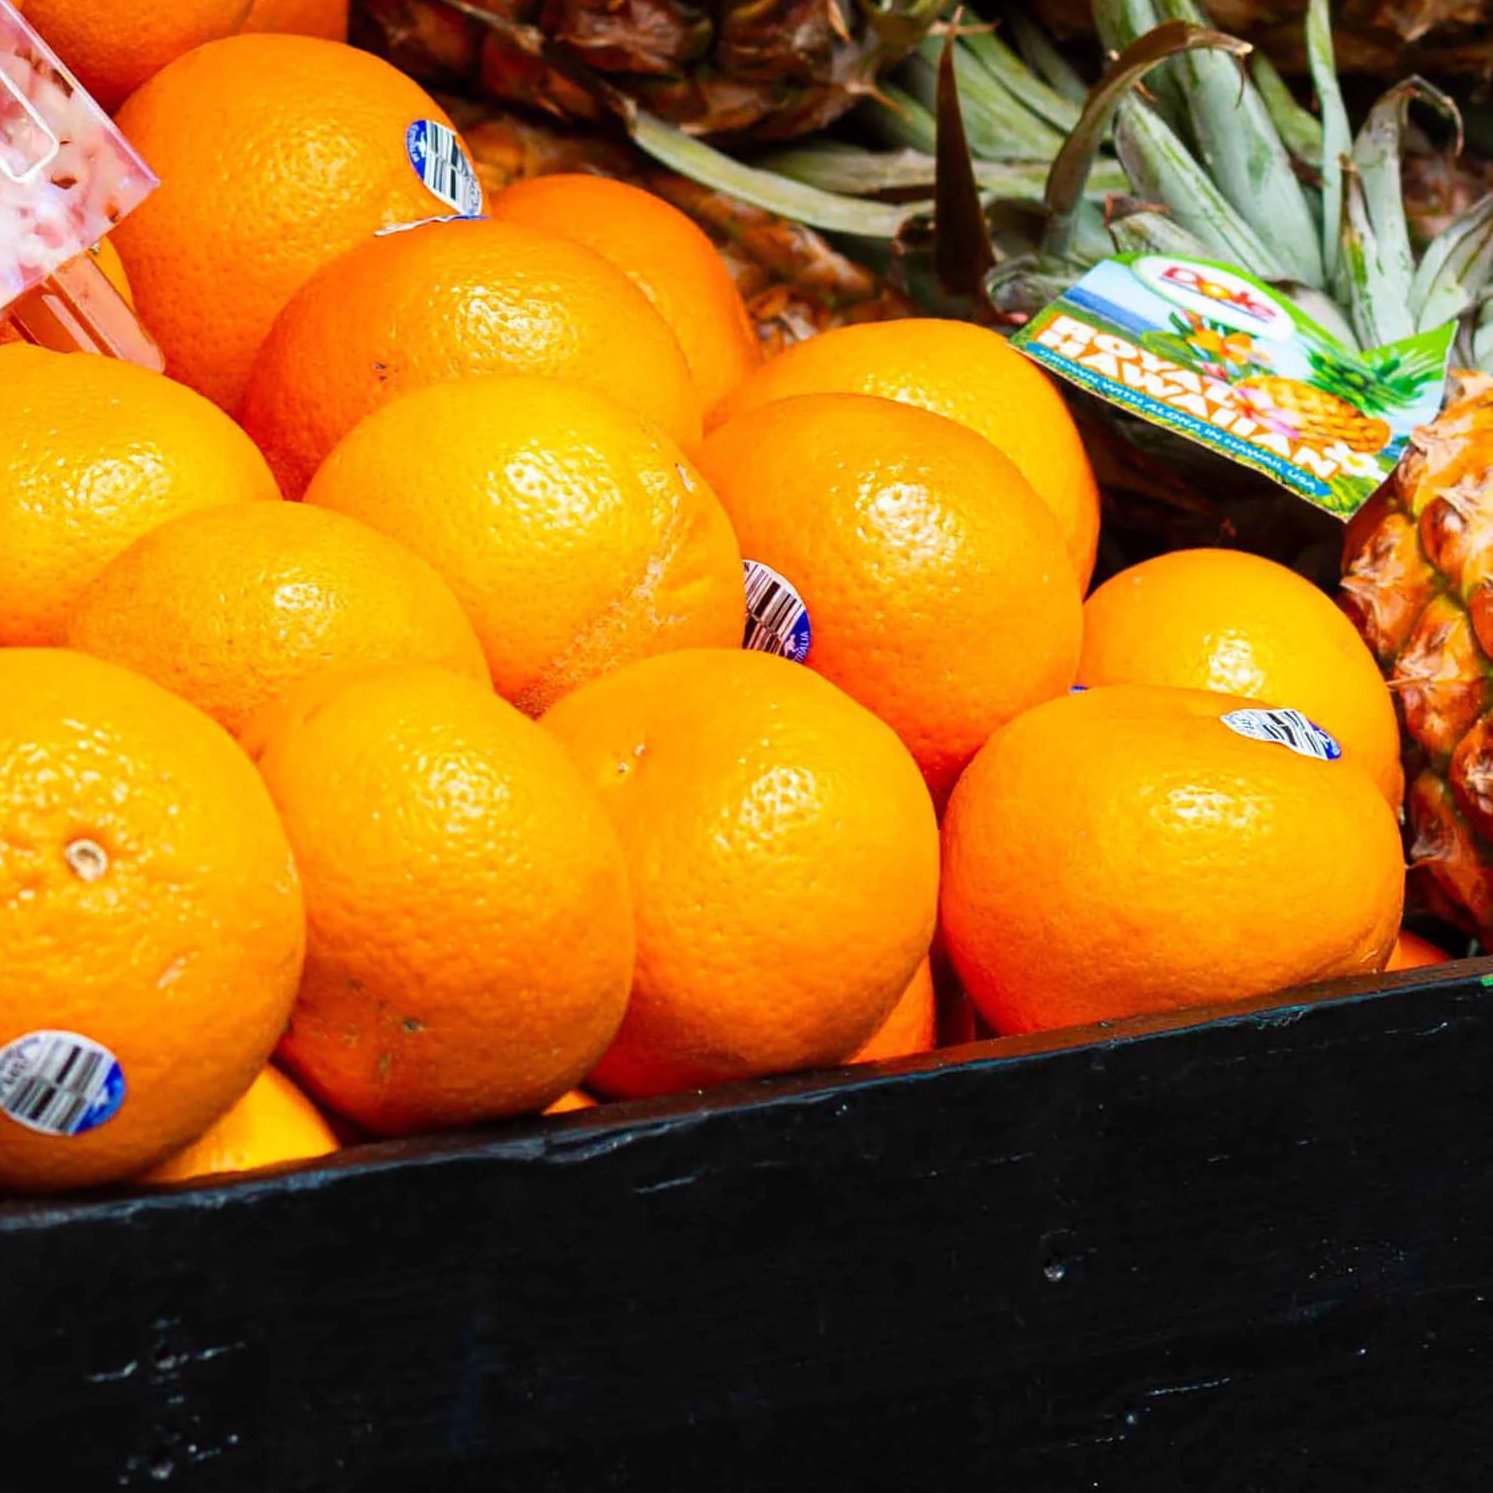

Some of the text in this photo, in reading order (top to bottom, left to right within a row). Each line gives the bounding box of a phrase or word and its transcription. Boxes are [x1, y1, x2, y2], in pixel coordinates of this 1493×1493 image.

[1162, 267, 1276, 318] Dole
[1037, 329, 1338, 478] HAWAIIAN
[1050, 315, 1237, 406] ROYAL
[1102, 379, 1144, 405] WITH
[1143, 403, 1201, 431] ALOHA
[1204, 427, 1223, 442] IN
[1286, 468, 1317, 491] USA
